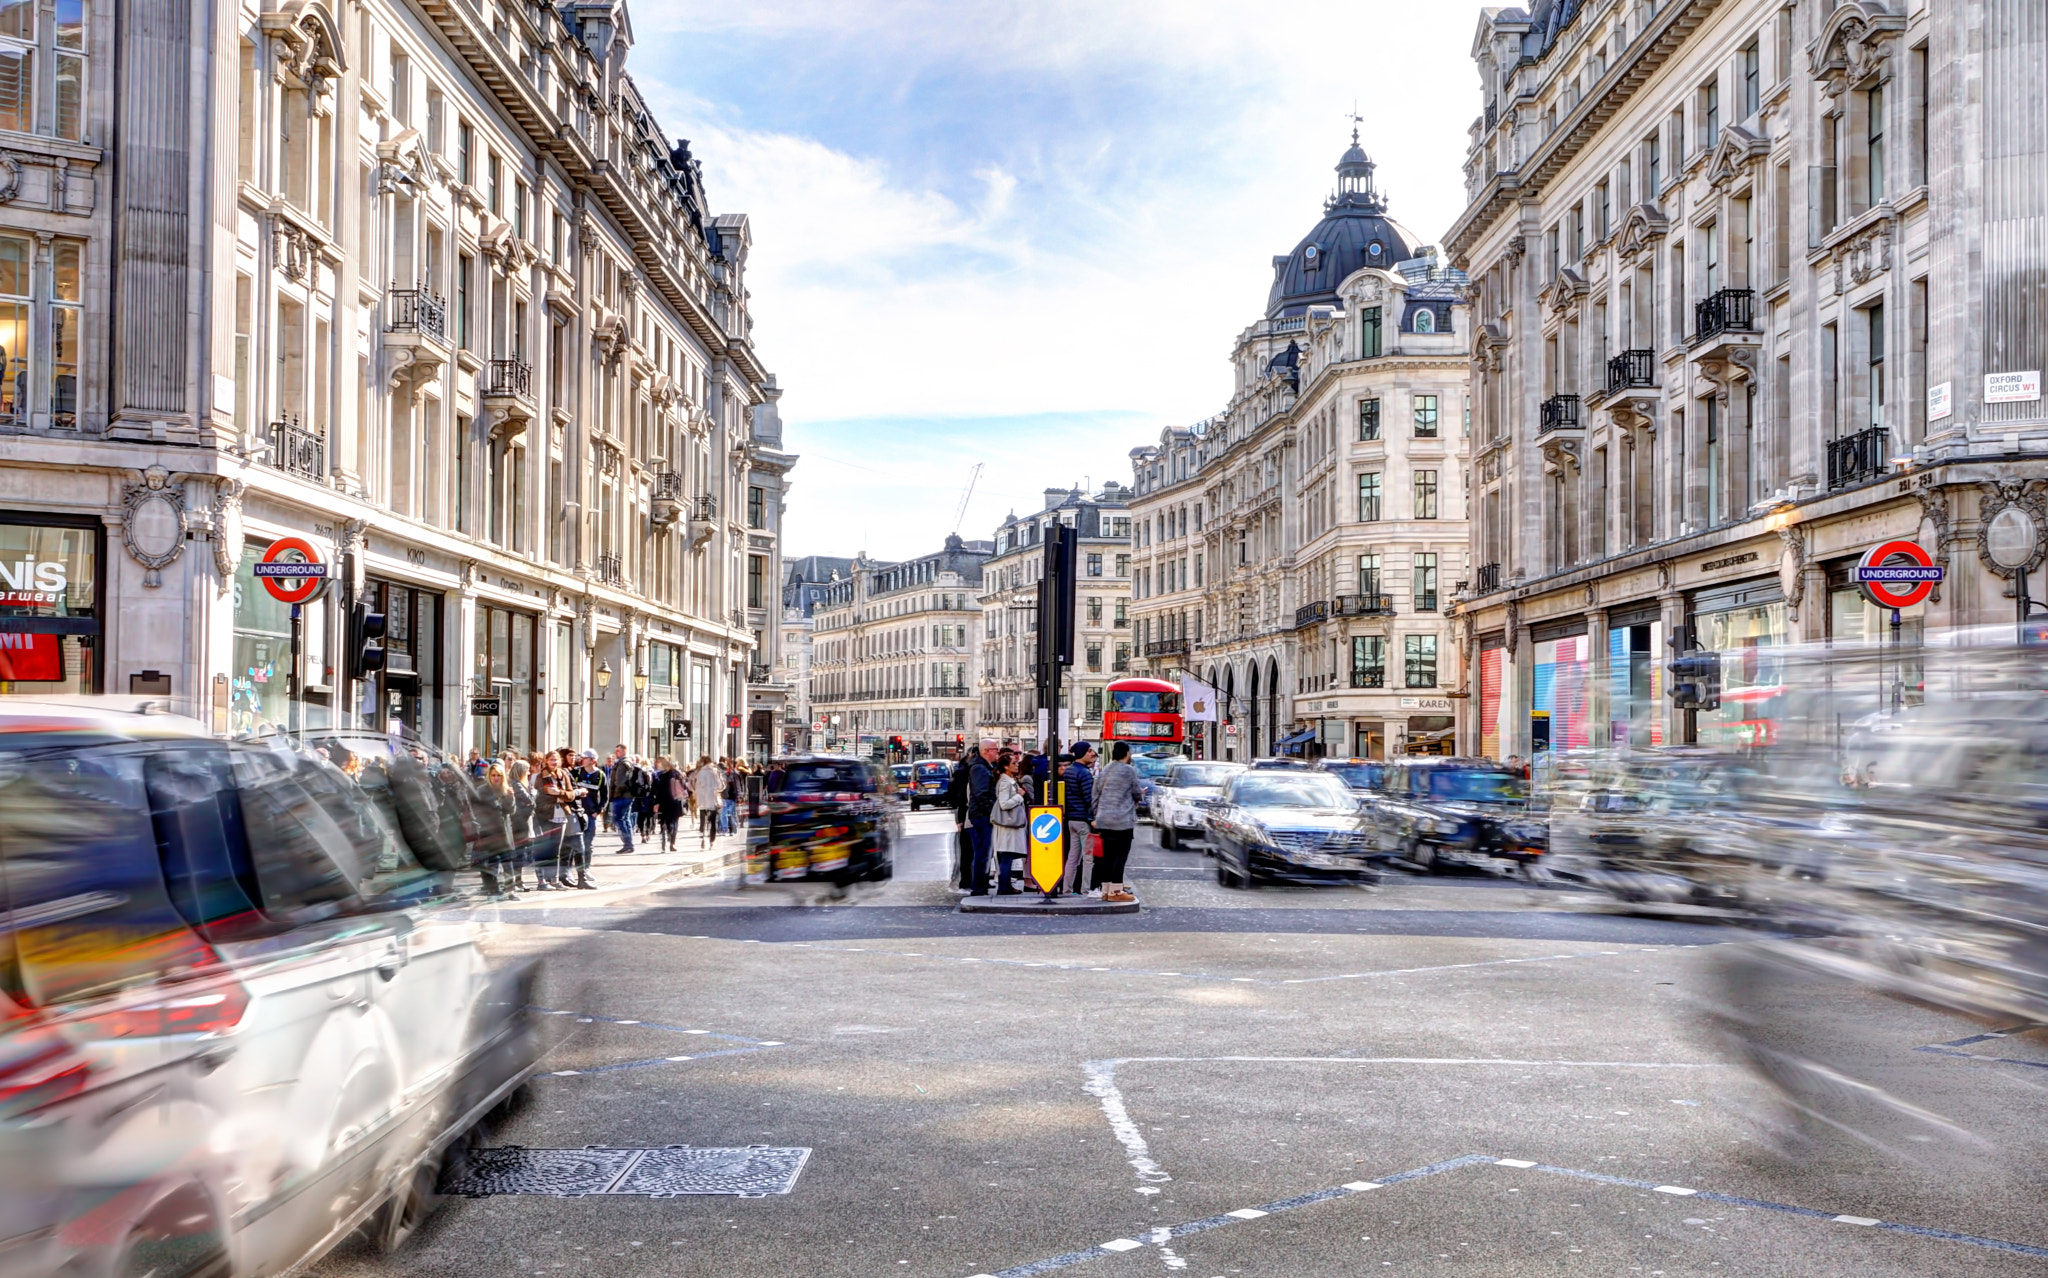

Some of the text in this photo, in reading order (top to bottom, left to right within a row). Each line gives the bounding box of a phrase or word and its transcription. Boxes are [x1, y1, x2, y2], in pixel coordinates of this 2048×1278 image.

[1989, 375, 2022, 384] OXFORD
[1989, 383, 2035, 393] CIRCUS W1
[407, 548, 425, 565] KIKO
[256, 565, 325, 575] UNDERGROUND
[1861, 569, 1940, 578] UNDERGROUND
[472, 702, 498, 710] KIKO
[1419, 699, 1451, 708] KAREN
[1156, 724, 1169, 734] 88
